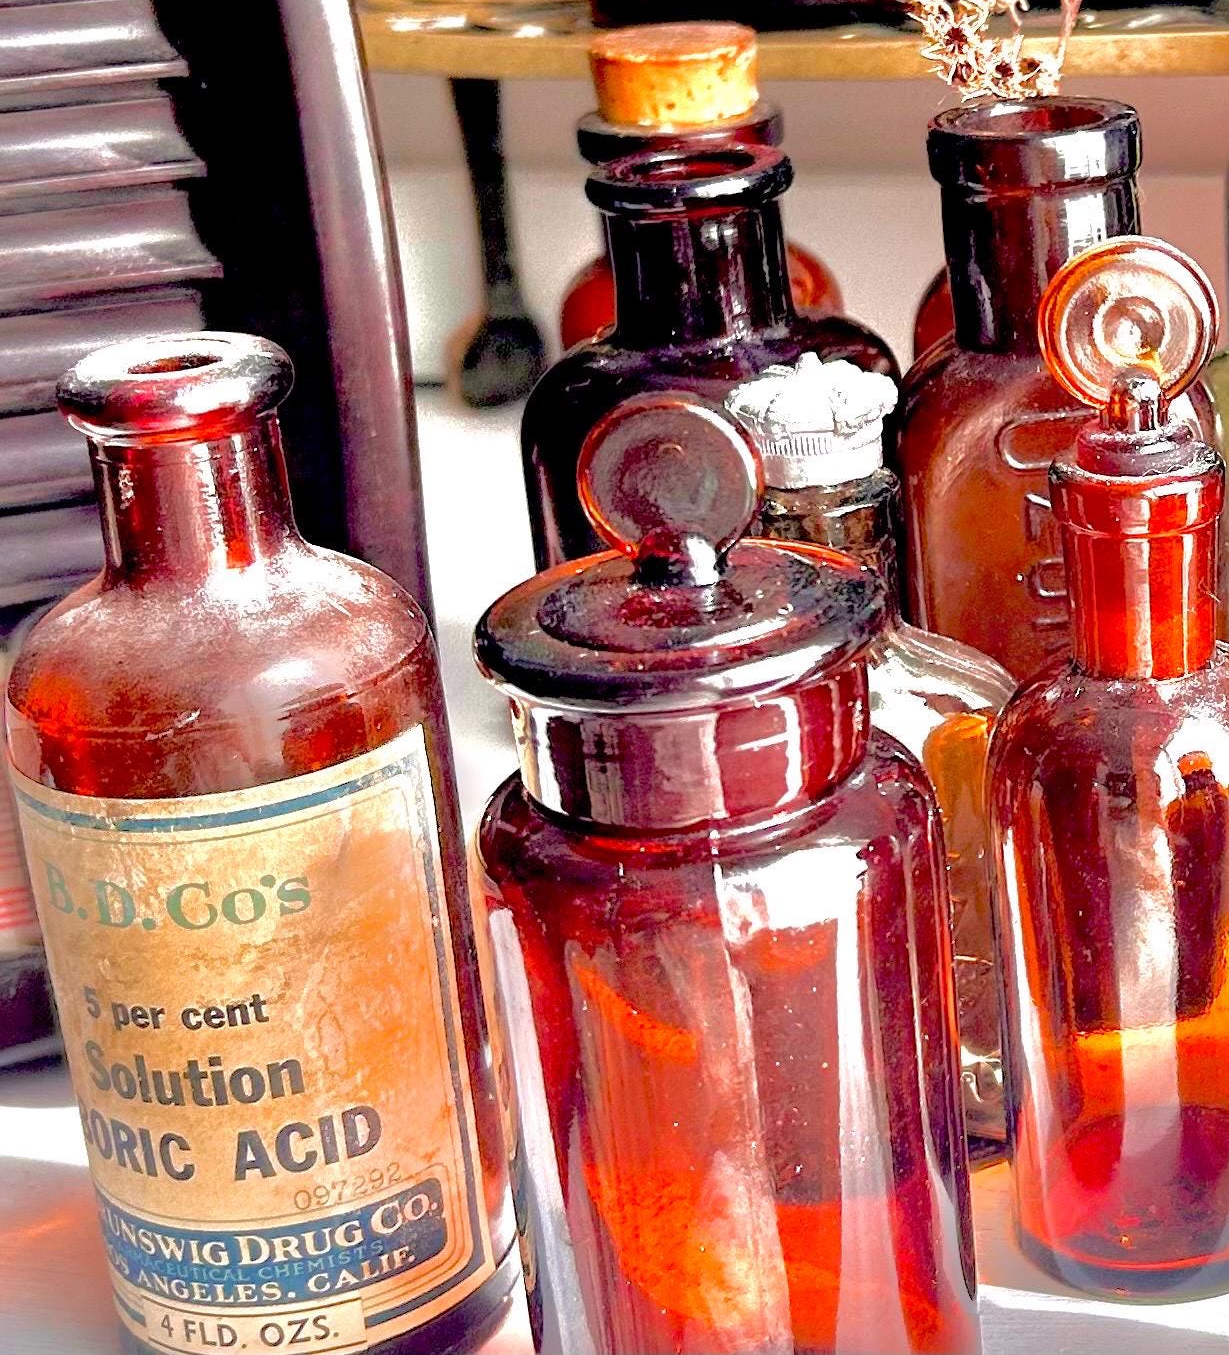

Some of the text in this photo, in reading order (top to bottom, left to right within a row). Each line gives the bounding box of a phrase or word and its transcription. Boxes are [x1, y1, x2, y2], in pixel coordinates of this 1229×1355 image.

[84, 985, 269, 1031] 5 per cent
[85, 1040, 305, 1107] Solution
[235, 1105, 382, 1181] ACID
[294, 1162, 402, 1210] 097292
[103, 1193, 438, 1266] UNSWIG DRUG CO.
[258, 1239, 384, 1280] CHEMISTS
[307, 1245, 416, 1293] CALIF.
[160, 1315, 339, 1349] 4 FLD. OZS.
